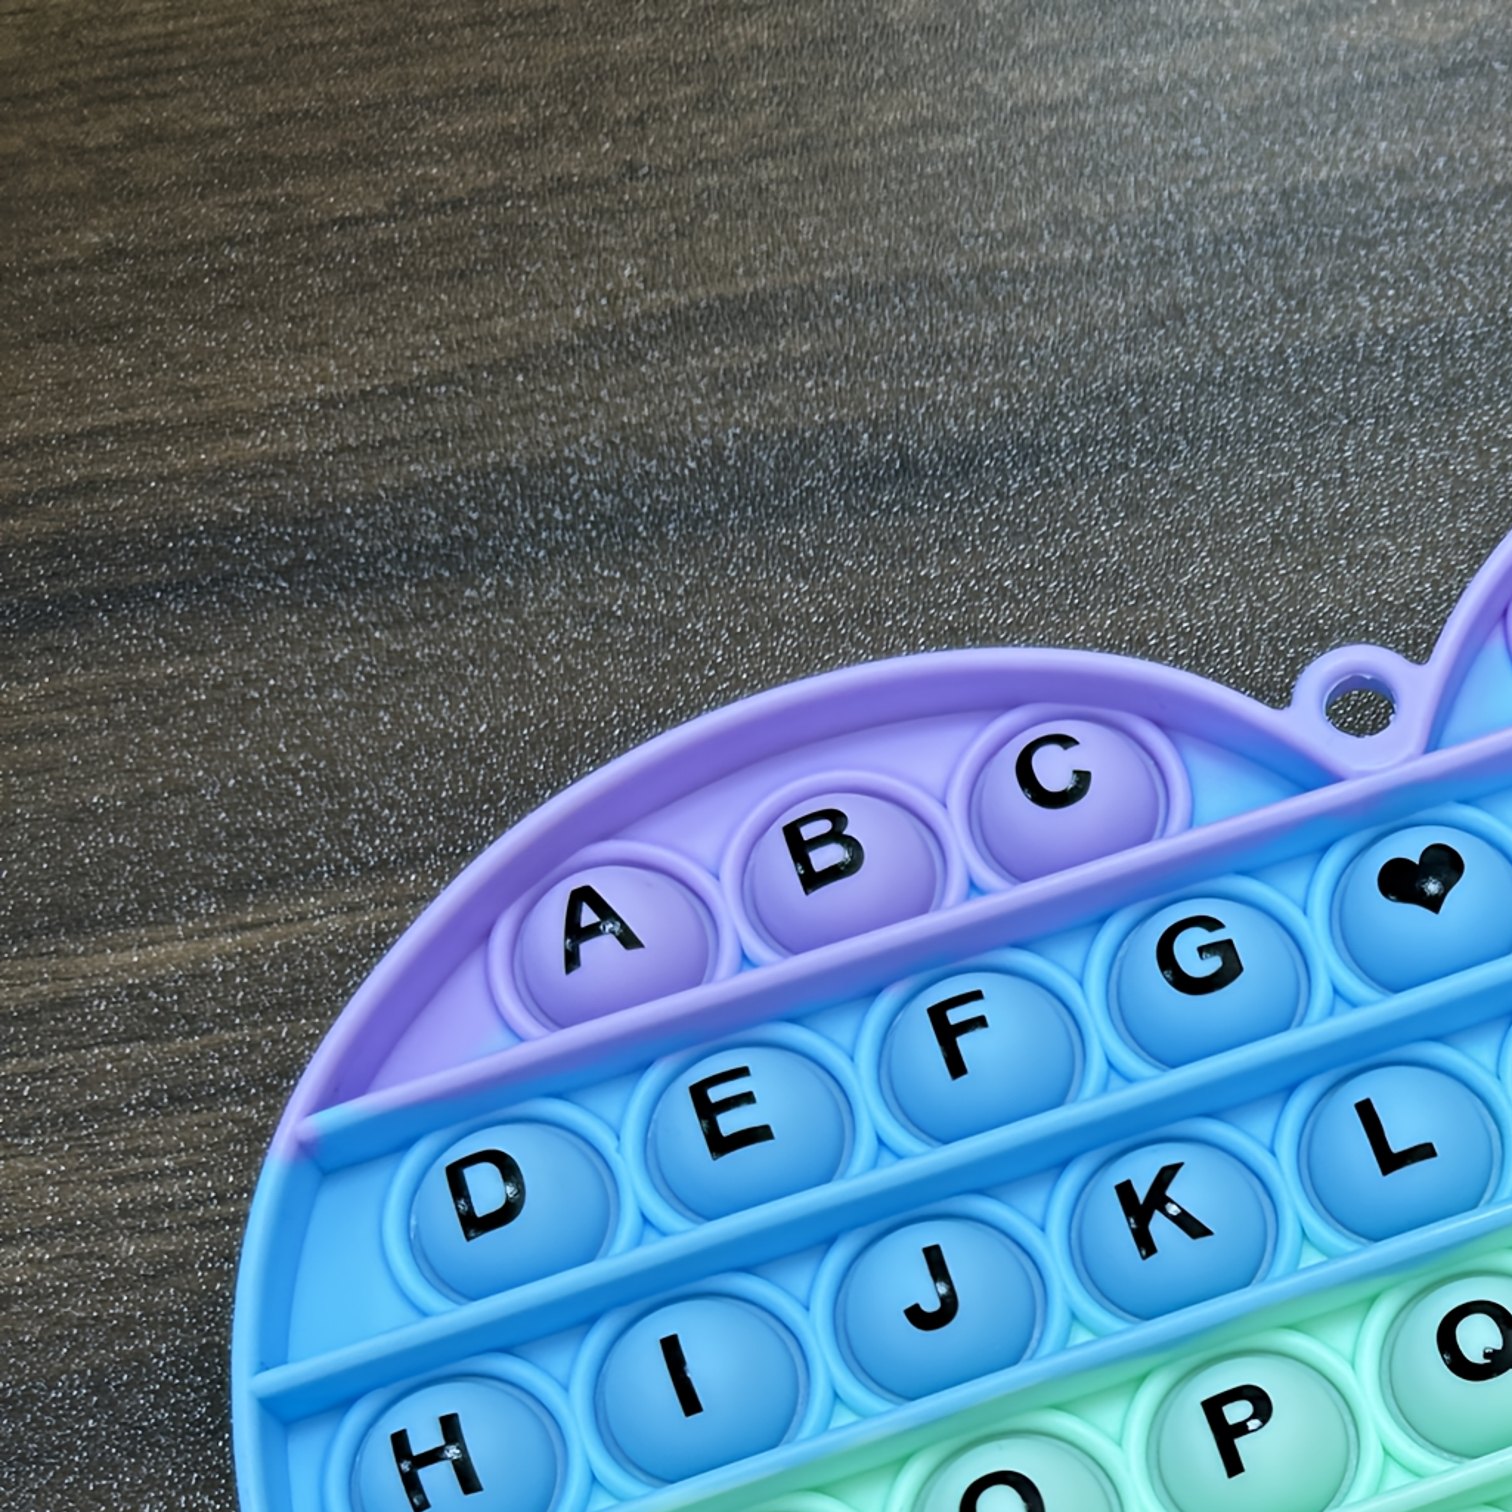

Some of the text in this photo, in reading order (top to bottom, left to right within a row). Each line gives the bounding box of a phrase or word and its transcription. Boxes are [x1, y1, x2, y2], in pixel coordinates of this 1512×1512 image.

[563, 733, 1092, 975] A B C
[445, 1149, 526, 1242] D
[688, 1066, 774, 1159] E
[926, 989, 989, 1080] F
[1156, 915, 1244, 996] G
[659, 1334, 703, 1418] I
[903, 1244, 959, 1332] J
[1114, 1162, 1214, 1260] K
[1354, 1098, 1438, 1177] L
[1200, 1384, 1274, 1479] P
